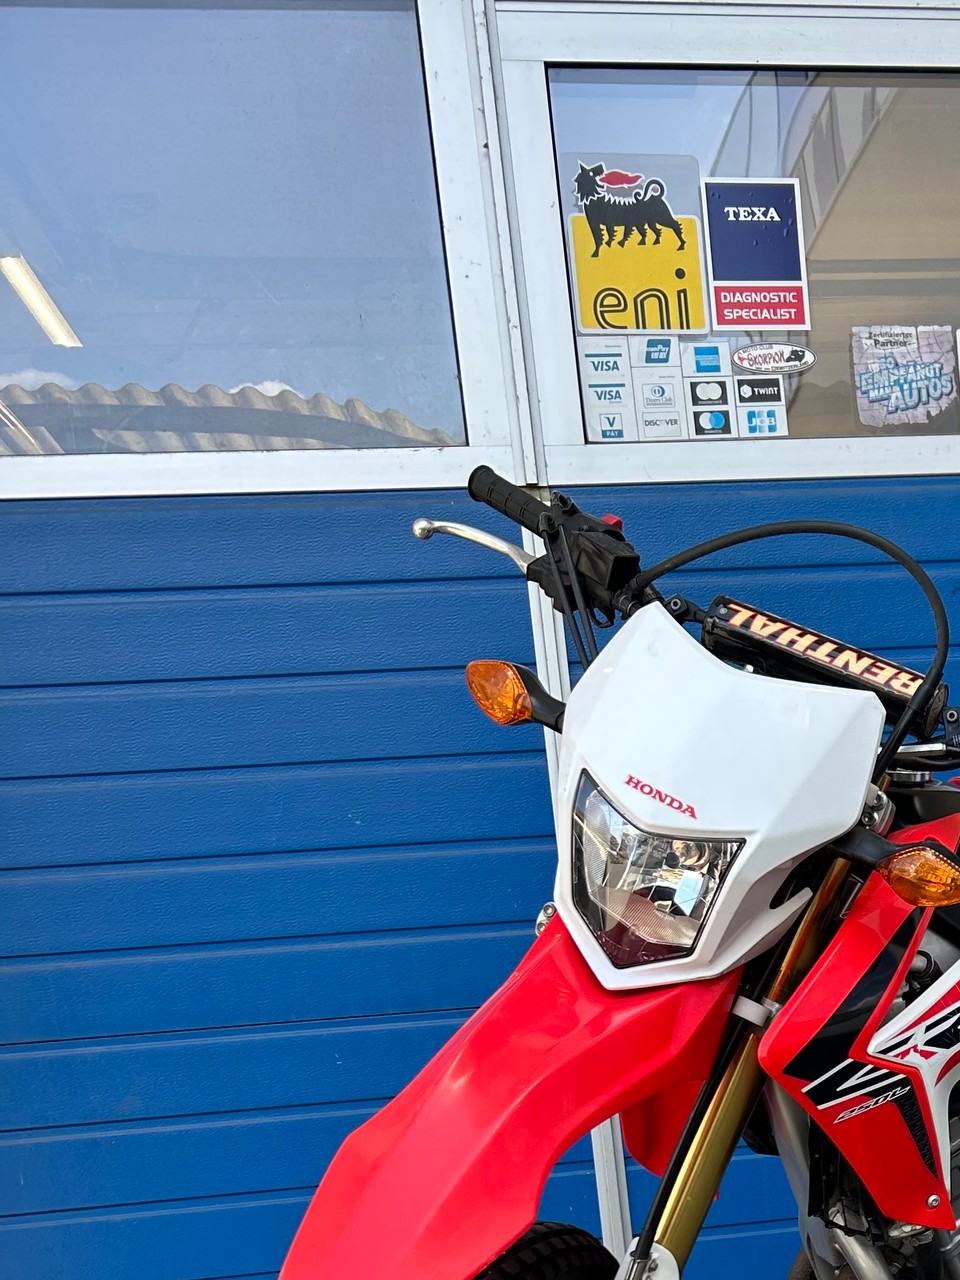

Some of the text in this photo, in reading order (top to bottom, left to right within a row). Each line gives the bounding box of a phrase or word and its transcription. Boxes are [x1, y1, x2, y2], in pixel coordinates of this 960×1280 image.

[724, 206, 781, 221] TEXA
[593, 267, 691, 330] eni
[720, 292, 798, 303] DIAGNOSTIC
[723, 308, 797, 320] SPECIALIST
[874, 339, 907, 347] Partner
[590, 360, 620, 372] VISA
[594, 390, 622, 401] VISA
[604, 416, 616, 428] V
[644, 418, 679, 427] DISCVER
[727, 603, 924, 698] RENTHAL
[625, 775, 698, 819] HONDA
